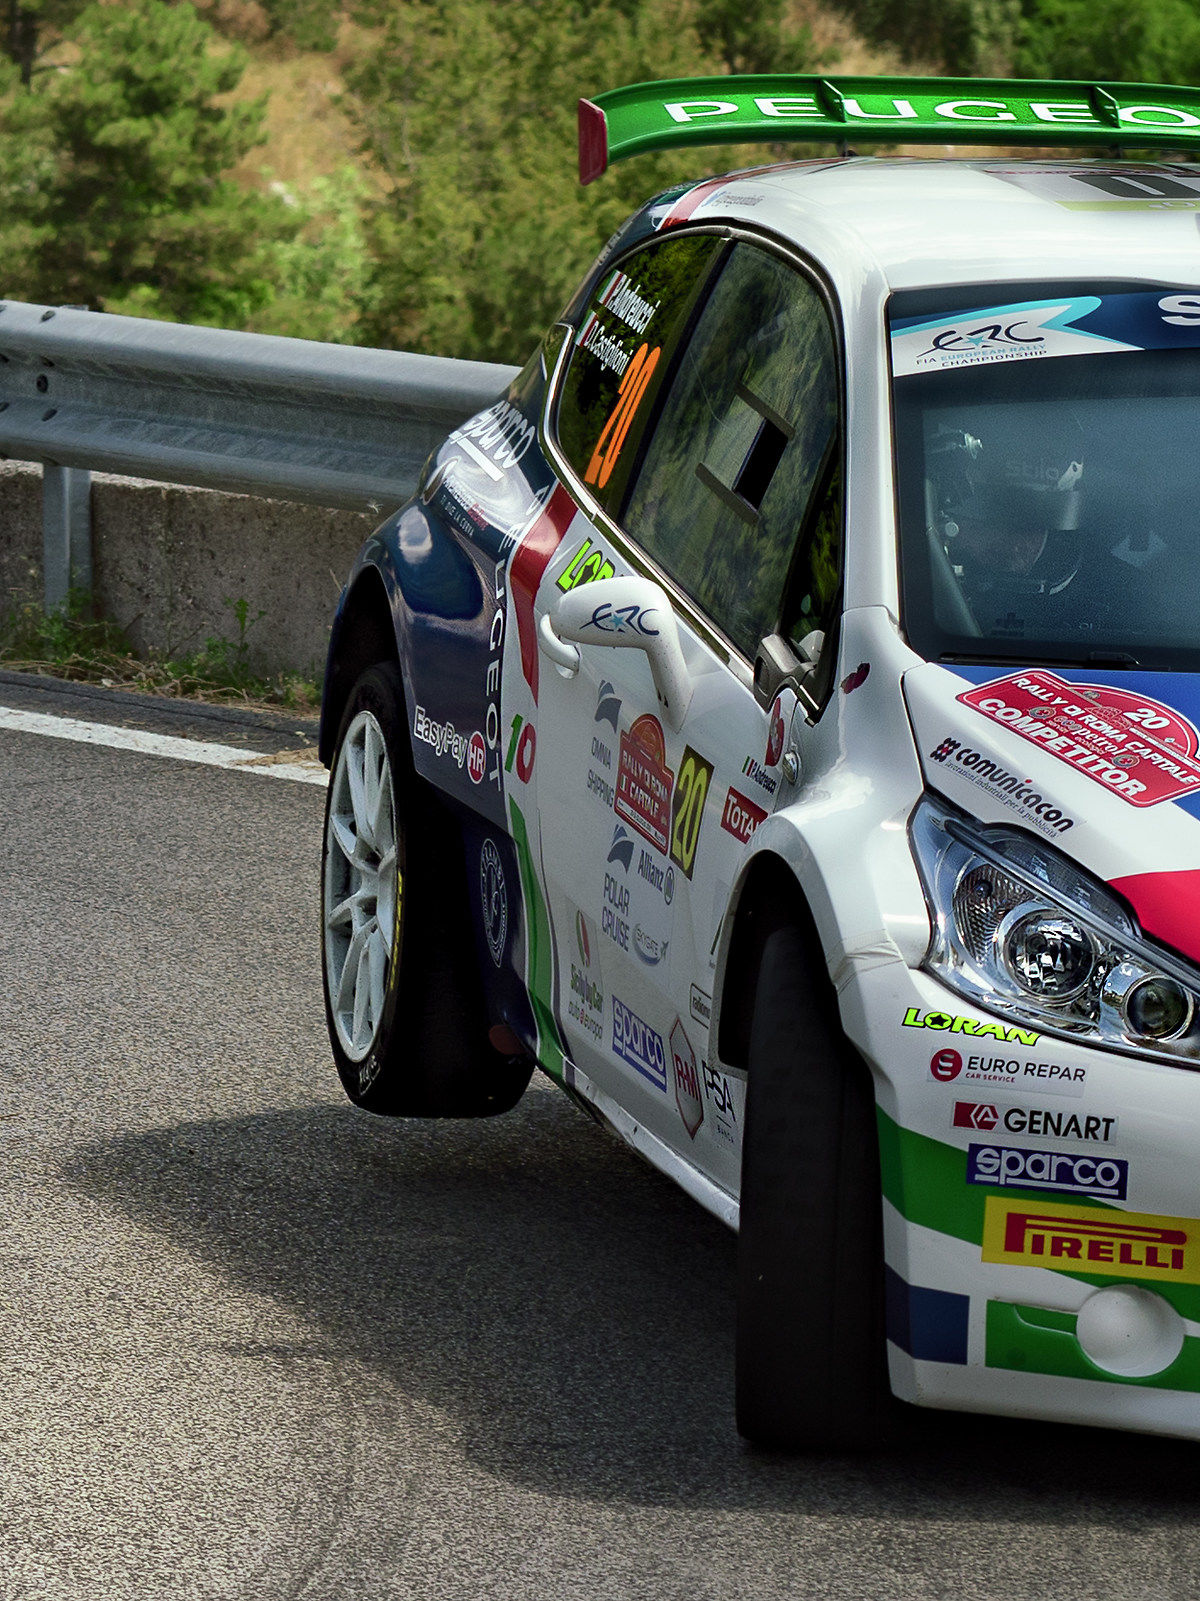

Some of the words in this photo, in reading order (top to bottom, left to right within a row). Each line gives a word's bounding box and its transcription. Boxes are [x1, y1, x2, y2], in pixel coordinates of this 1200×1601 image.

[916, 321, 1045, 358] ERC
[916, 357, 937, 366] FIA
[940, 347, 1008, 363] EUROPEAN
[1010, 344, 1046, 355] RALLY
[941, 350, 1047, 367] CHAMPIONSHIP
[449, 400, 535, 469] sparco
[584, 342, 661, 489] 20
[555, 537, 618, 594] LOR
[414, 704, 468, 769] EasyPay
[1011, 677, 1068, 706] RALLY
[1062, 704, 1086, 718] DI
[1082, 714, 1128, 743] ROMA
[1124, 740, 1200, 785] CAPITALE
[1123, 707, 1170, 730] 20
[978, 697, 1148, 797] COMPETITOR
[956, 747, 1075, 833] comunicacon
[672, 757, 707, 871] 20
[728, 793, 760, 839] TOTA
[638, 849, 664, 893] Allianz
[603, 872, 630, 917] POLAR
[602, 905, 630, 953] CRUISE
[613, 1000, 665, 1073] sparco
[902, 1007, 1041, 1047] LORAN
[965, 1072, 982, 1081] CAR
[983, 1074, 1016, 1084] SERVICE
[967, 1056, 1021, 1076] EURO
[1024, 1062, 1086, 1083] REPAR
[1003, 1107, 1115, 1142] GENART
[974, 1147, 1120, 1187] sparco
[1003, 1211, 1188, 1271] PIRELLI
